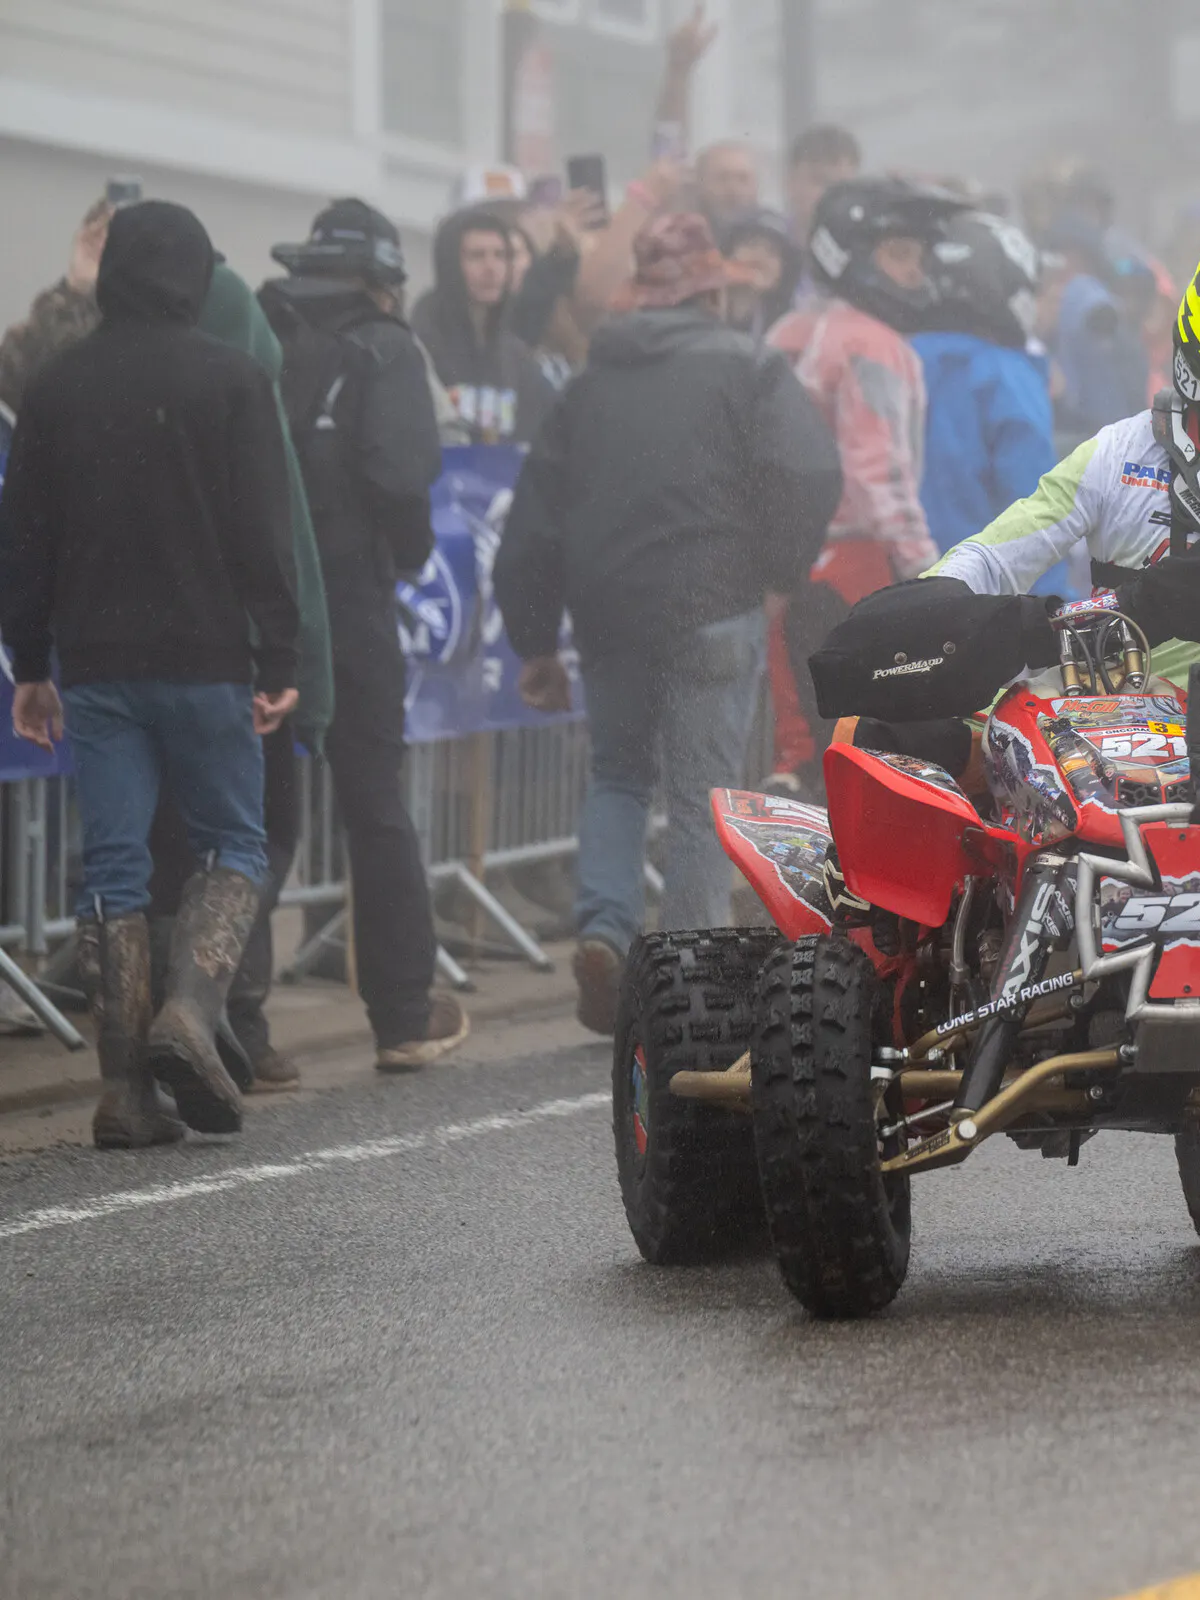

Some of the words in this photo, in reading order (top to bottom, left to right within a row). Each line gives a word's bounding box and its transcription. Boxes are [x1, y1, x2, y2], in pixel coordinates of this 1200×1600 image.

[1175, 359, 1199, 399] 521
[1057, 699, 1121, 713] McGill
[1154, 722, 1169, 735] 3
[1100, 733, 1188, 759] 521
[1002, 882, 1057, 998] AXIS
[937, 1011, 975, 1035] LONE
[977, 992, 1017, 1019] STAR
[1020, 972, 1074, 1002] RACING
